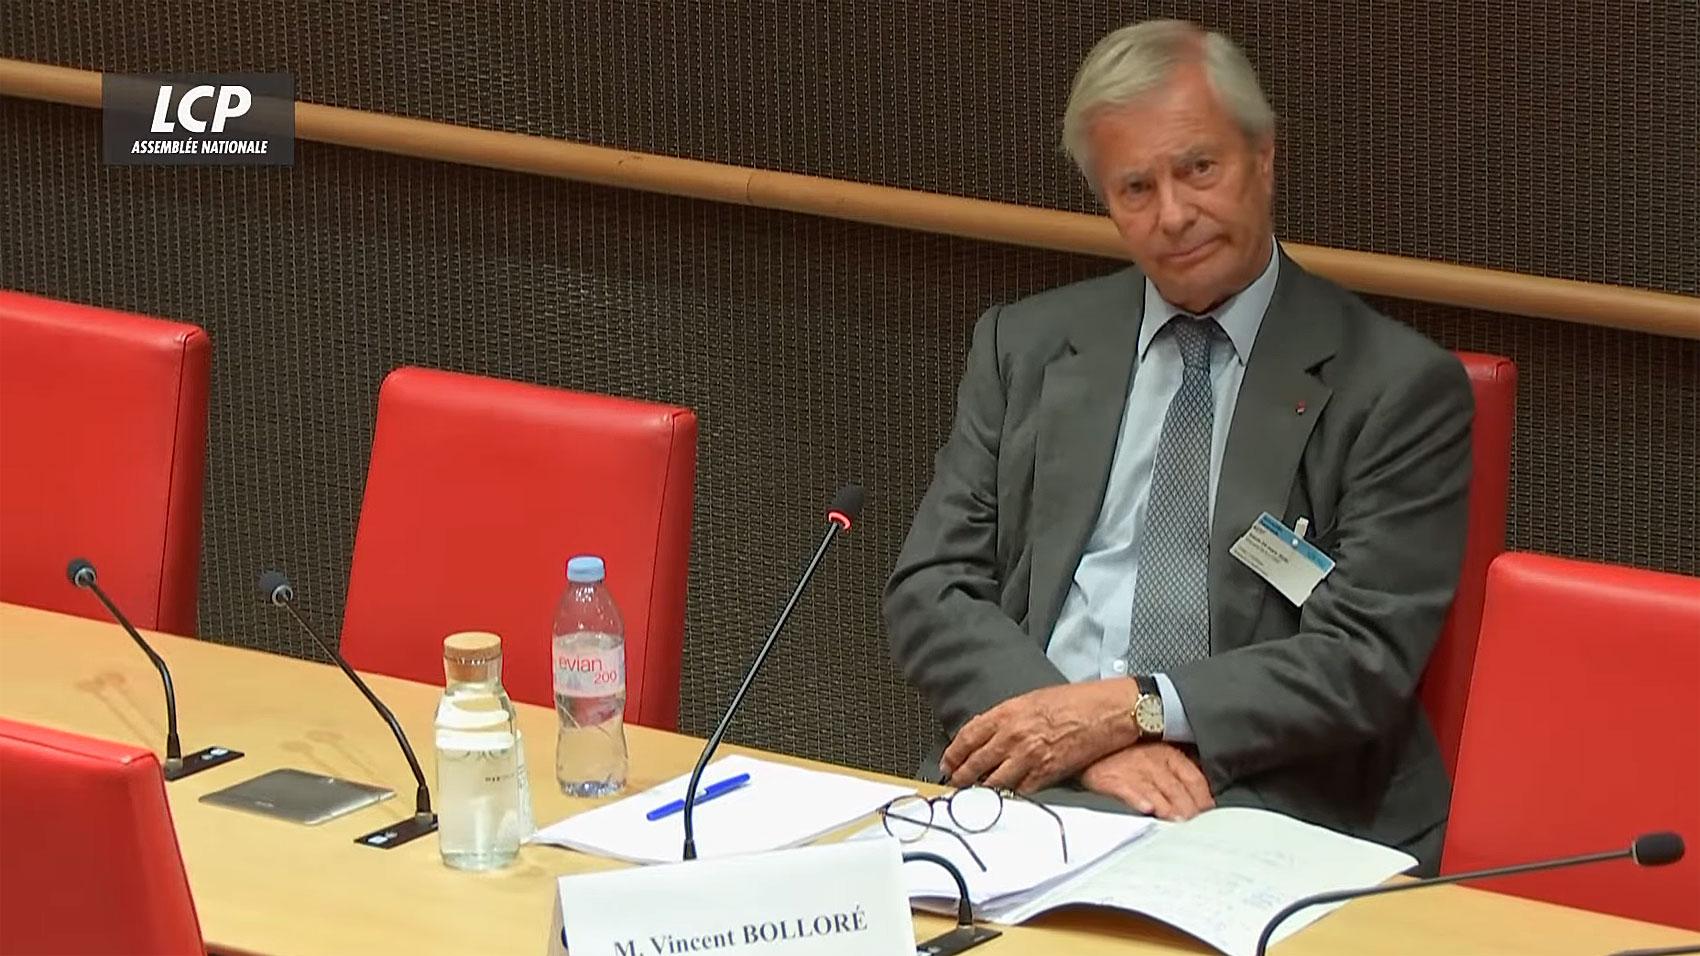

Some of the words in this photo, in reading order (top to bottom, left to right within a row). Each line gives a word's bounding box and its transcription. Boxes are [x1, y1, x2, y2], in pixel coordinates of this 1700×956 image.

[559, 656, 602, 672] evian
[594, 671, 617, 684] 200
[650, 929, 735, 955] Vincent
[742, 904, 868, 945] BOLLORÉ
